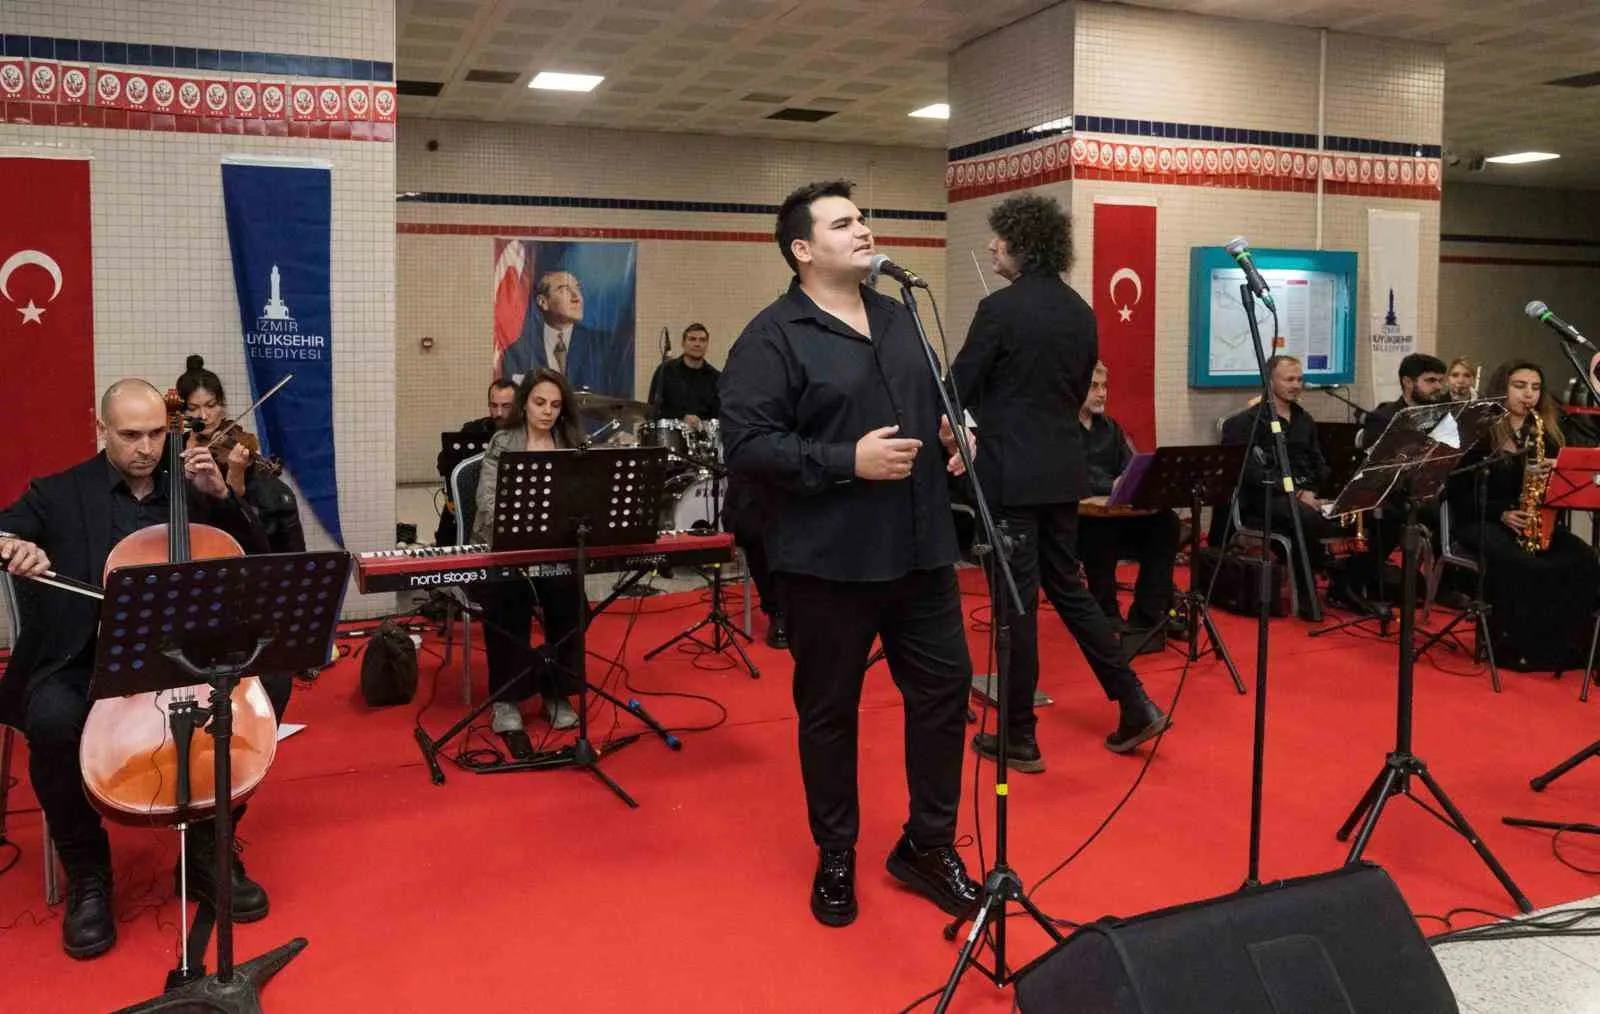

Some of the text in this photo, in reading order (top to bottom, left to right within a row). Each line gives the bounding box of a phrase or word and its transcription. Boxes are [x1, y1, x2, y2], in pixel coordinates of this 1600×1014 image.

[410, 569, 487, 586] nord stage 3
